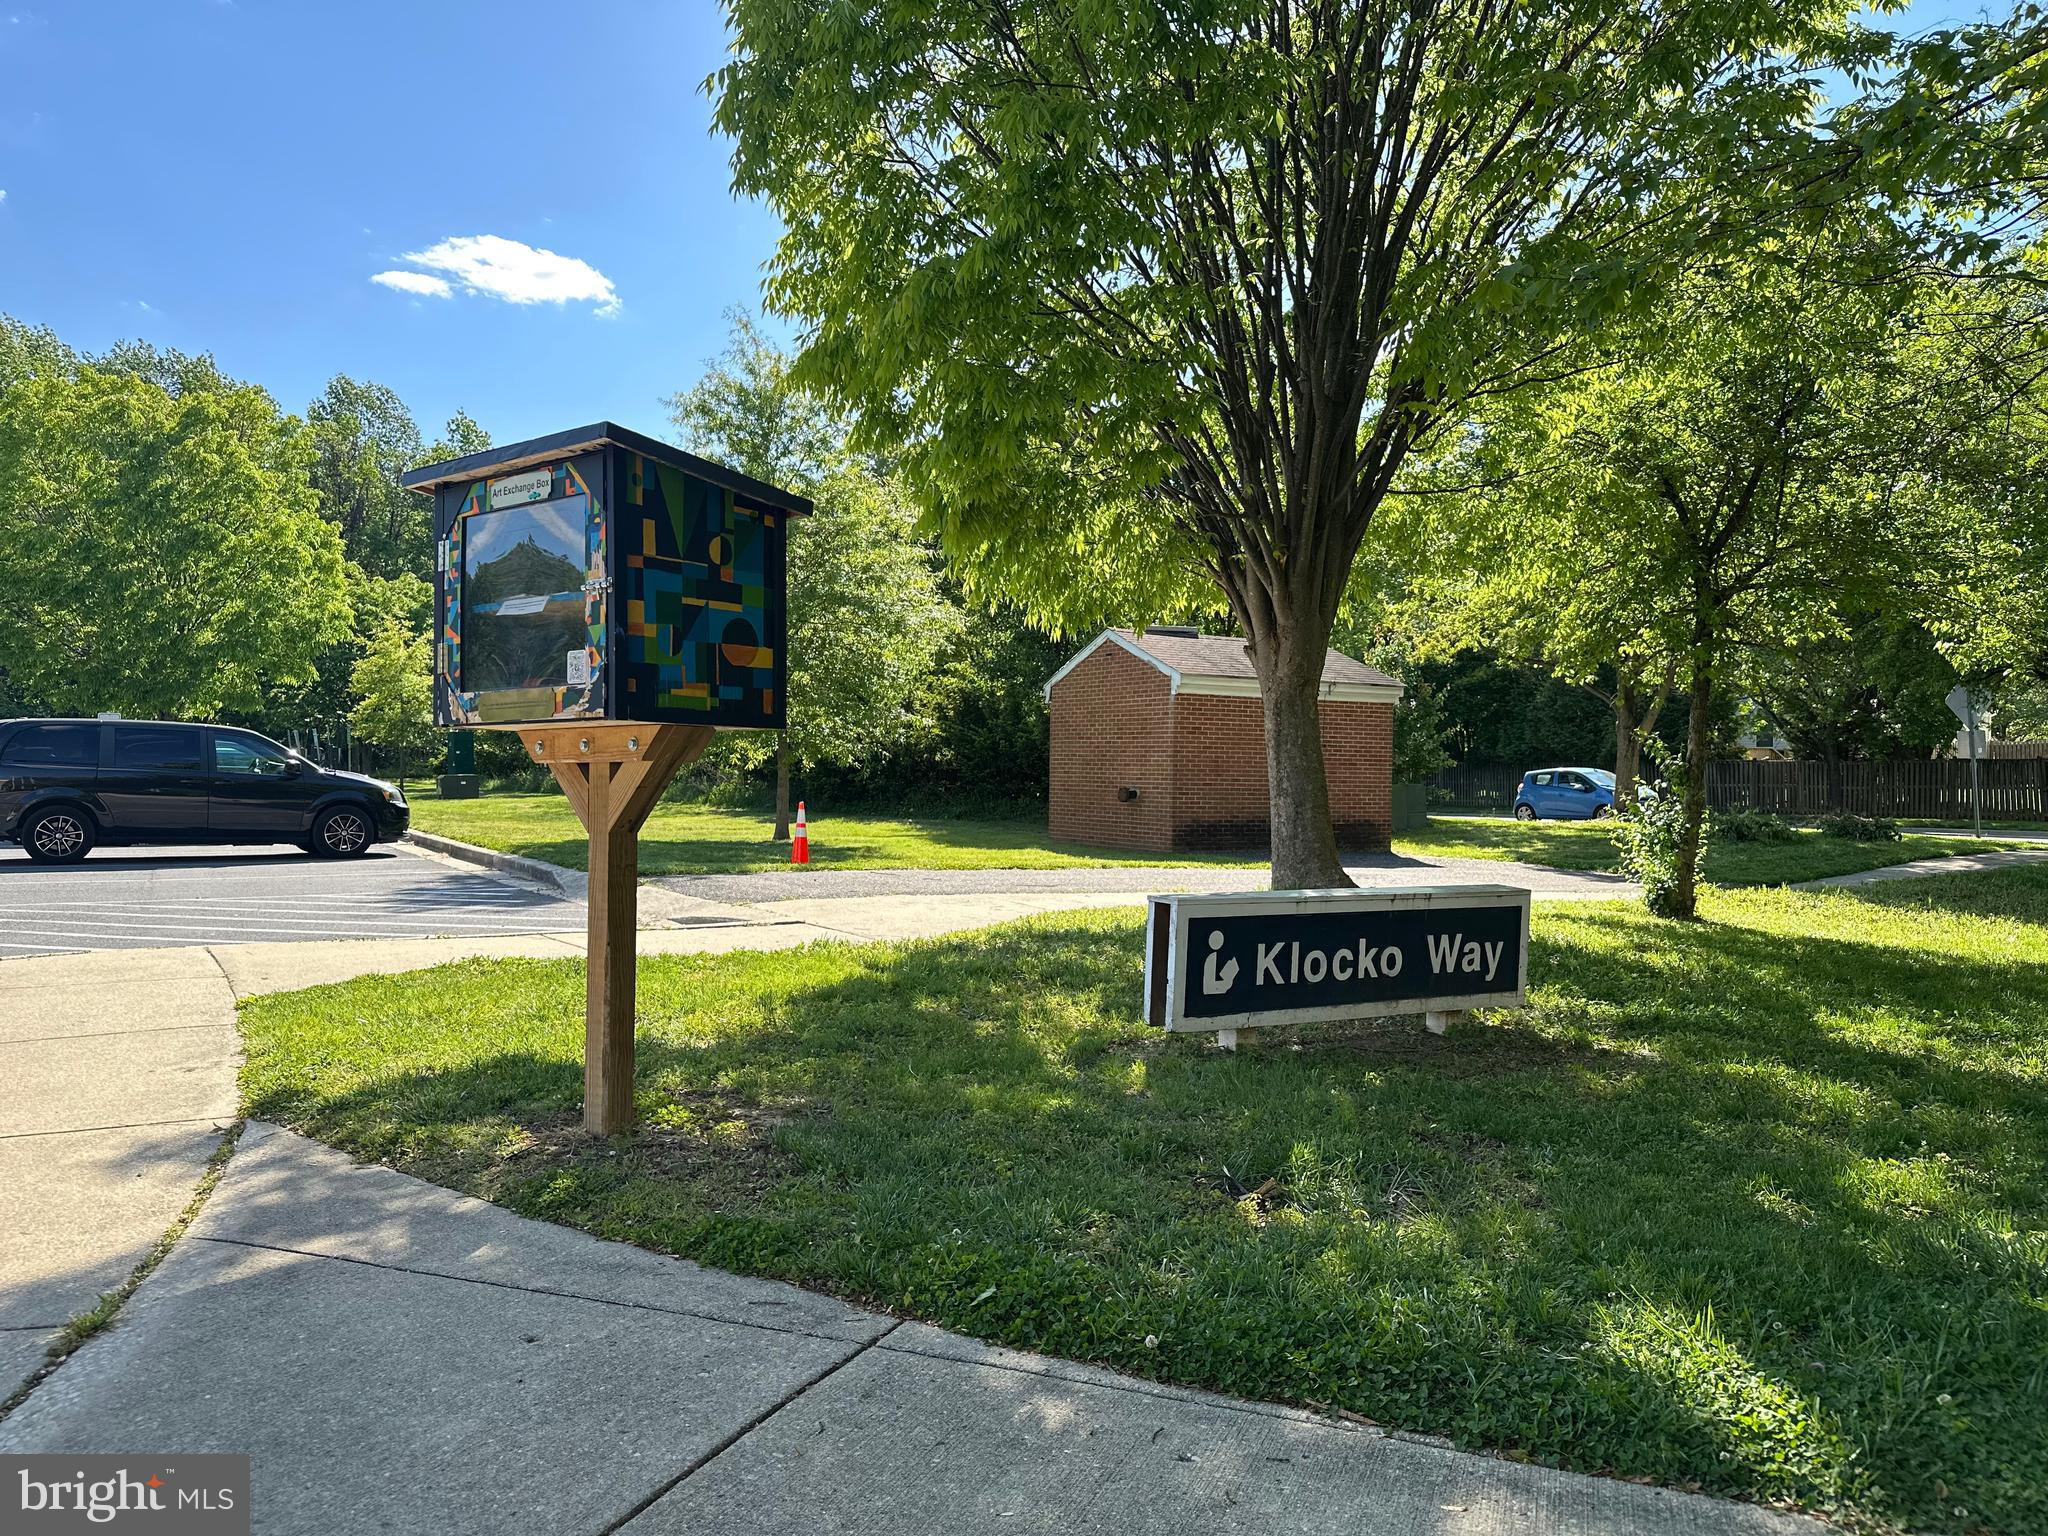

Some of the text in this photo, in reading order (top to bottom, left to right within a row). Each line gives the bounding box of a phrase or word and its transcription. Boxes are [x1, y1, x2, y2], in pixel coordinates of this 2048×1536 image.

[492, 479, 550, 498] Art Exchange Box
[1256, 933, 1504, 986] Klocko Way
